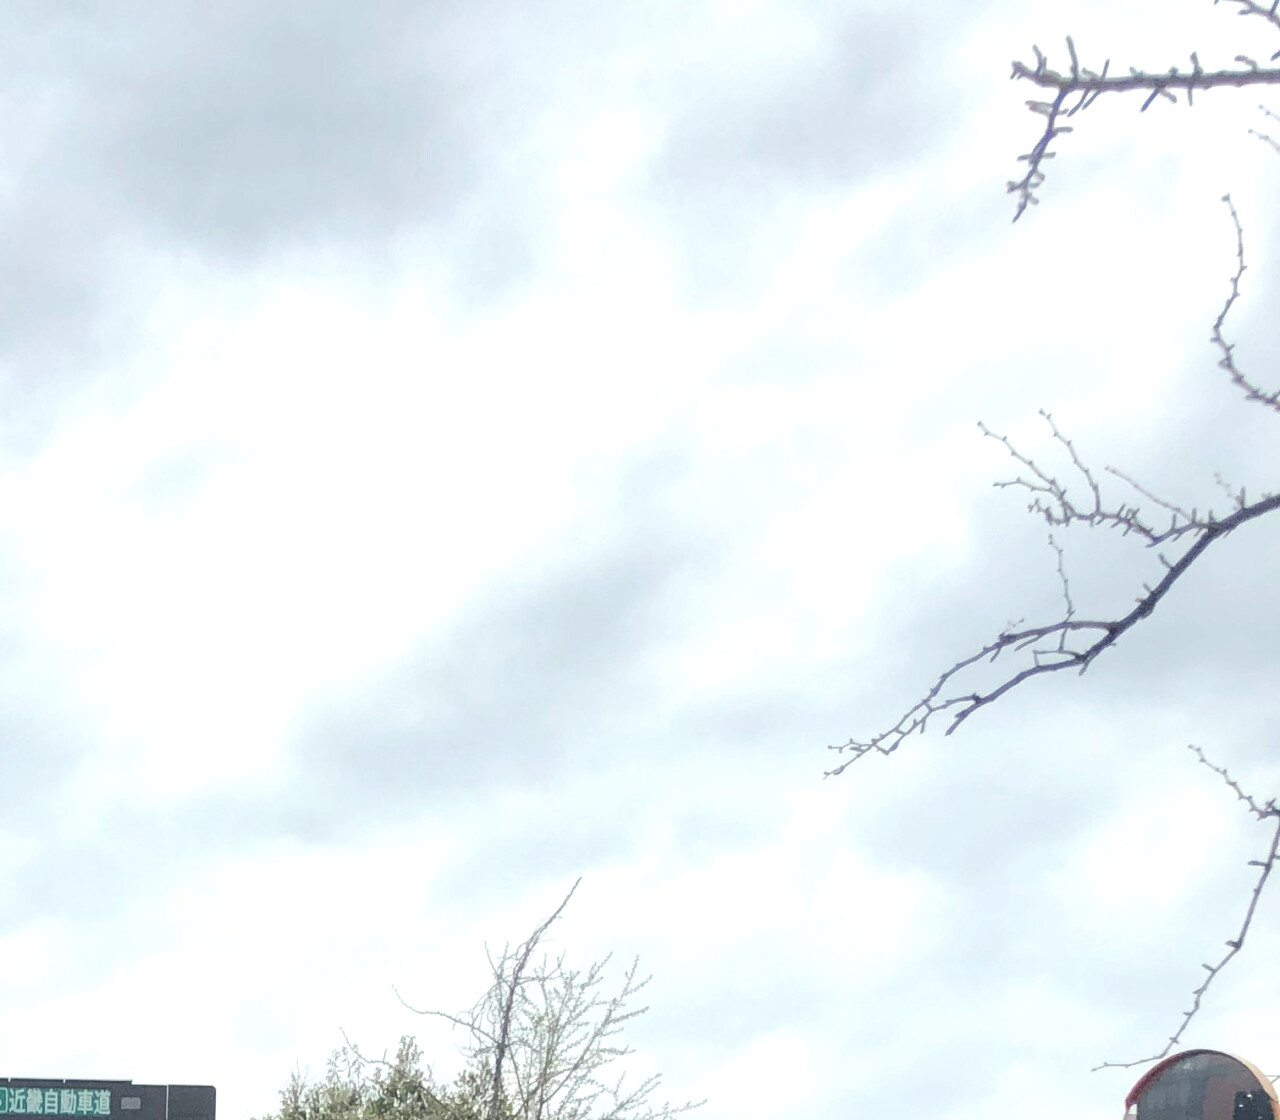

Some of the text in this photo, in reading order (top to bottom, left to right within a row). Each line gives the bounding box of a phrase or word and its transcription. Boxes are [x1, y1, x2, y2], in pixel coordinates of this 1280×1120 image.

[9, 1088, 111, 1114] 近畿自動車道
